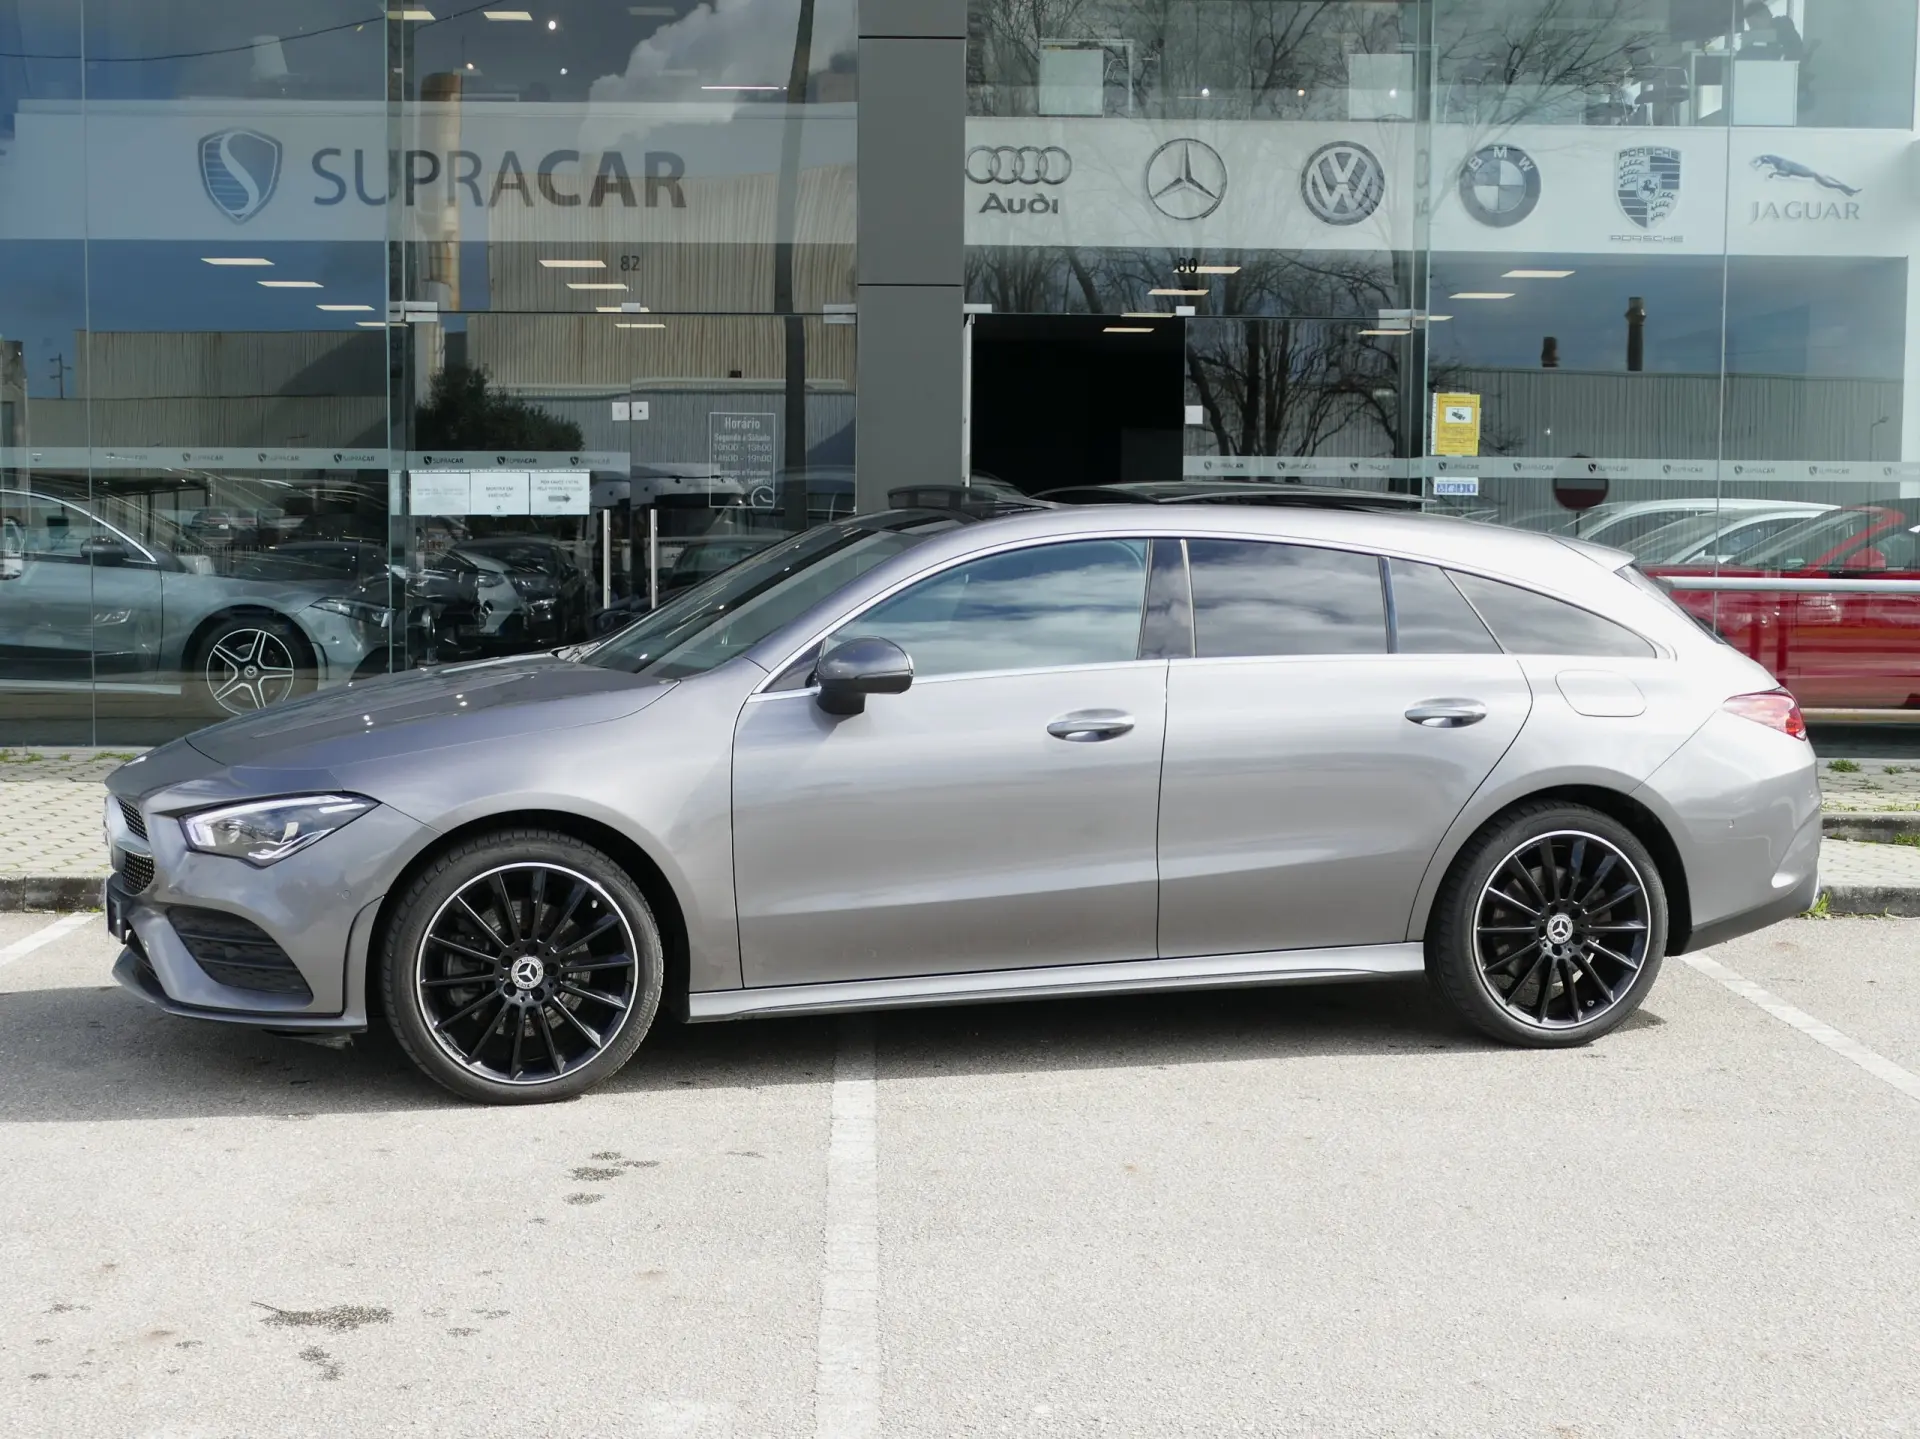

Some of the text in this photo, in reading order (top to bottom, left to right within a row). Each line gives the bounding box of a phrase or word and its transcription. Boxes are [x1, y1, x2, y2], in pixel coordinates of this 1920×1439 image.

[1467, 145, 1535, 172] BMW
[311, 147, 688, 209] SUPRACAR
[1750, 201, 1861, 224] JAGUAR
[1609, 234, 1684, 243] PORSCHE
[620, 254, 641, 272] 82
[1176, 256, 1198, 274] 80
[724, 416, 761, 430] Horário
